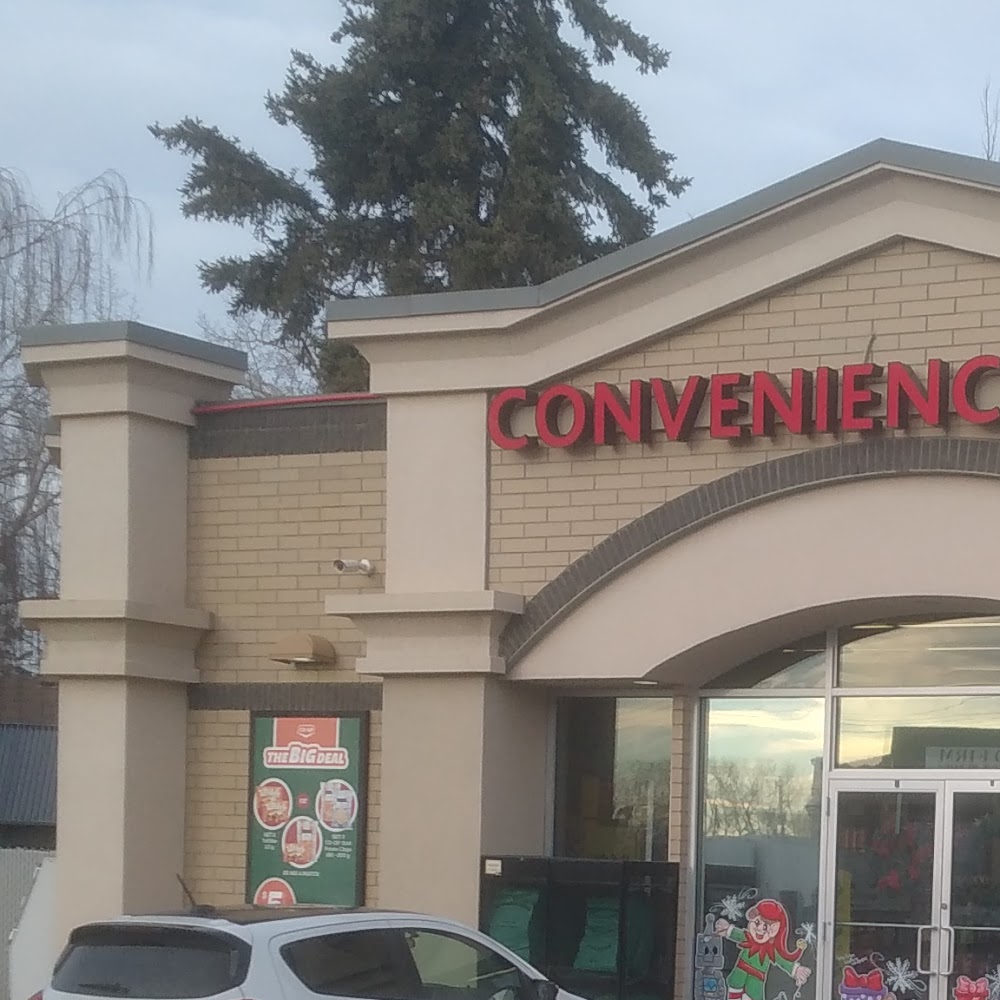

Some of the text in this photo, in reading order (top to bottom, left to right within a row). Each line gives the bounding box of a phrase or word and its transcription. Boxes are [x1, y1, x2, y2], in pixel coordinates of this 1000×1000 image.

[267, 746, 345, 765] THE BIG DEAL
